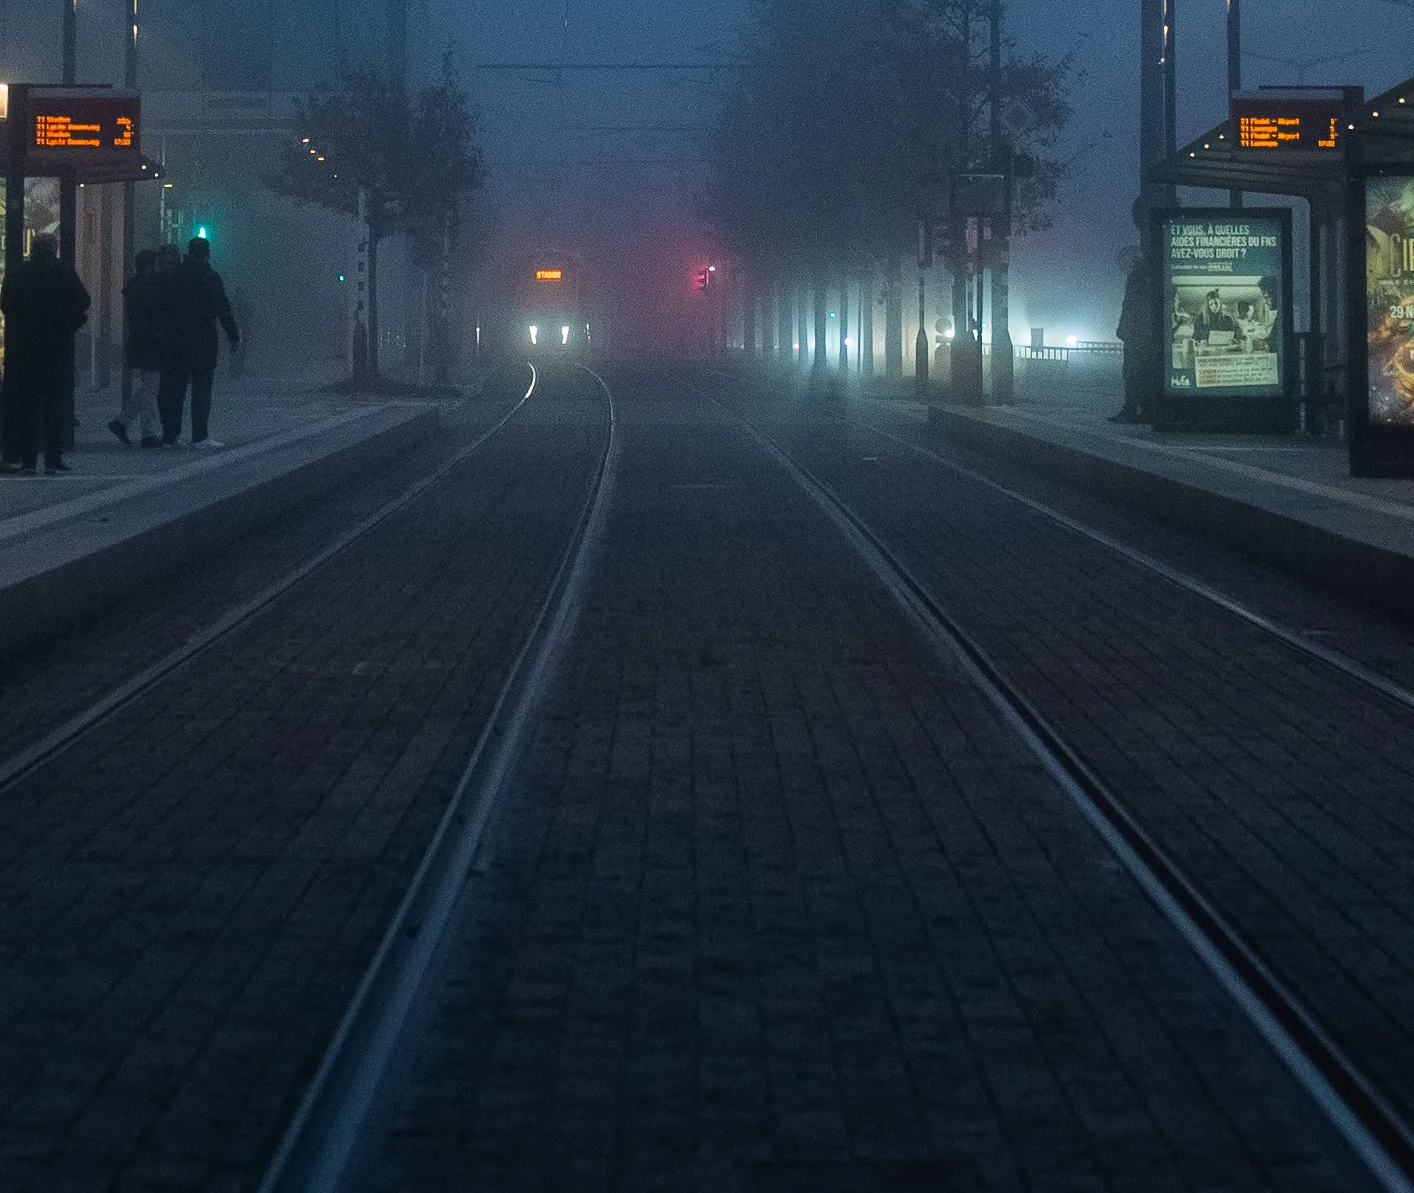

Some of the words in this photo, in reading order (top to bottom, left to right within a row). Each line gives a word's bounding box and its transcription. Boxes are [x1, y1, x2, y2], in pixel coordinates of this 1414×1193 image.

[1171, 225, 1180, 235] ET
[1215, 225, 1251, 235] QUELLES
[1171, 236, 1194, 247] AIDES
